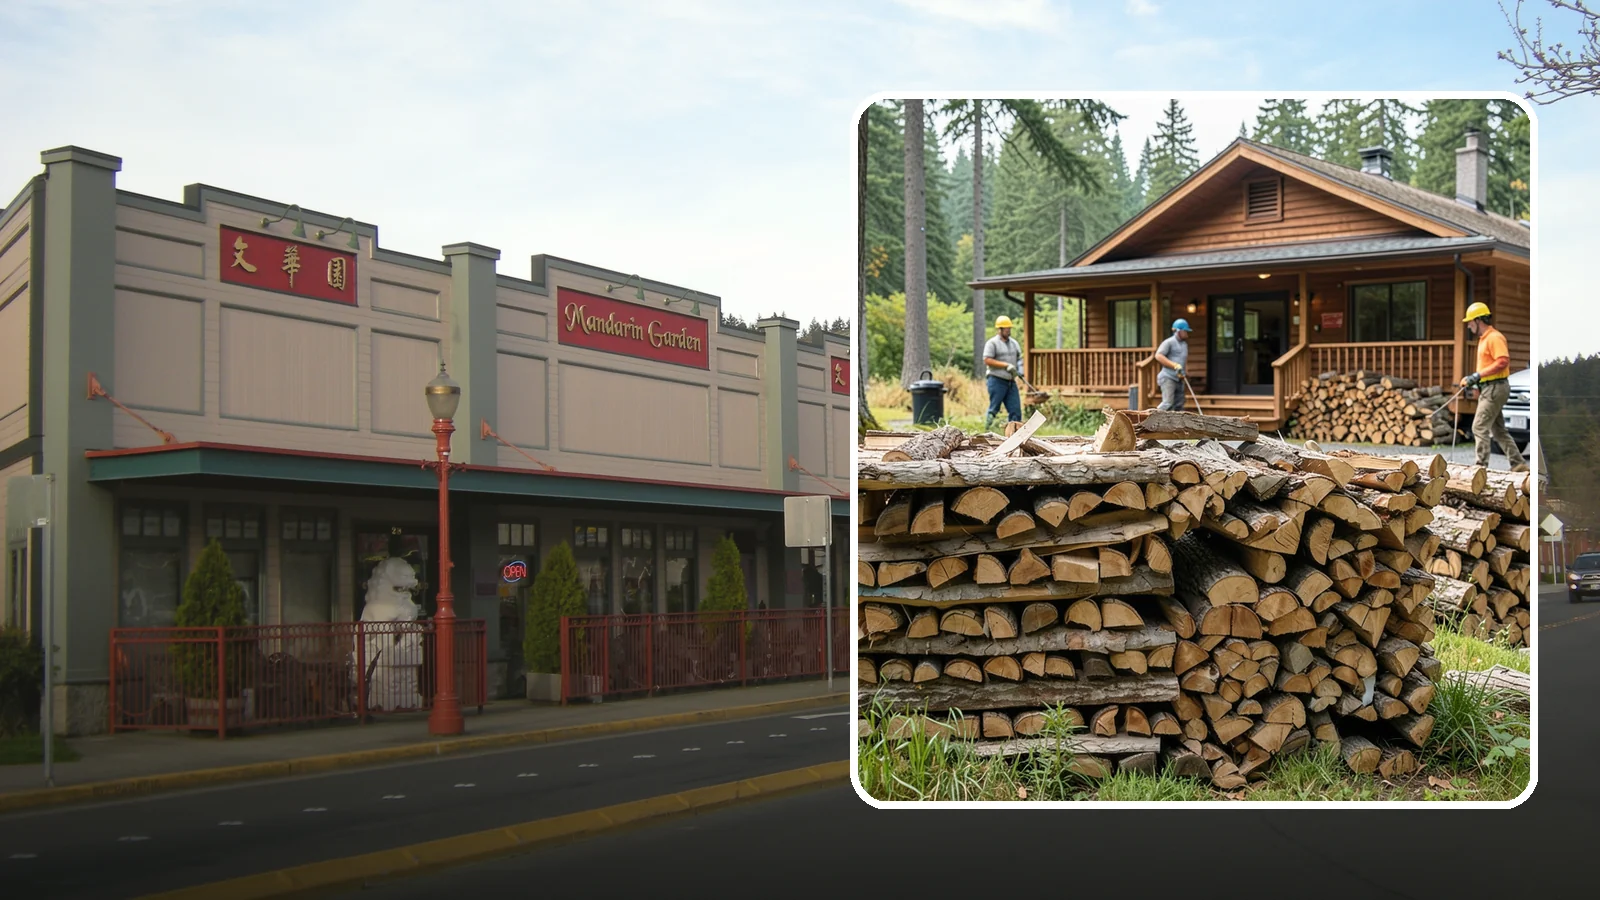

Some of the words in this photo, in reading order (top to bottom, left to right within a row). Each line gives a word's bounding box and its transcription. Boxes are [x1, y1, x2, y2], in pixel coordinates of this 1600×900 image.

[231, 235, 346, 290] 文華園
[564, 302, 643, 340] Mandarin
[647, 320, 701, 352] Garden
[503, 565, 526, 578] OPEN
